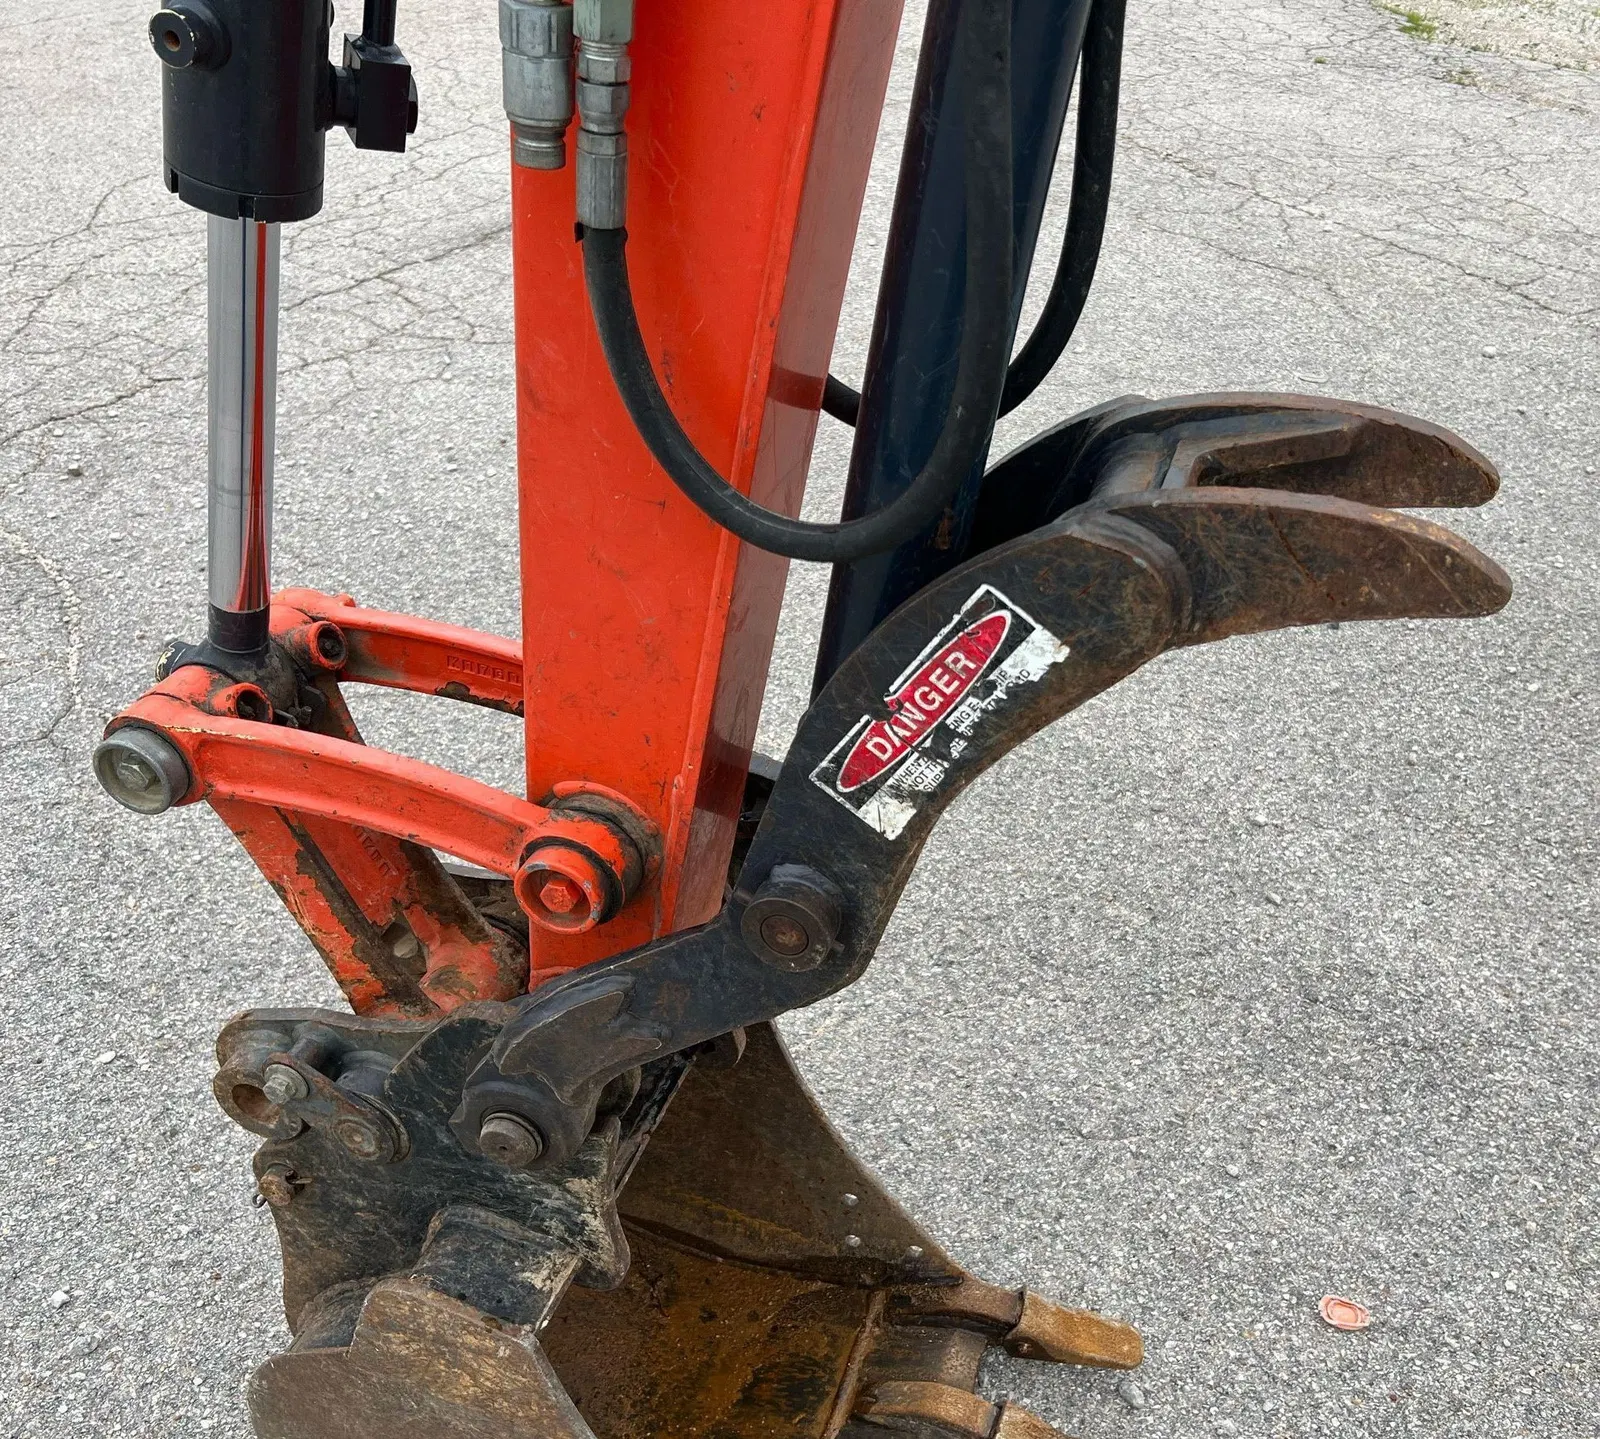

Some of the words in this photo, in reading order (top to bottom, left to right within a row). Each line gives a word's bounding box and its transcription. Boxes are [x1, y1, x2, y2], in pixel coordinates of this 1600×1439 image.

[865, 651, 976, 762] DANGER
[892, 761, 922, 787] WHEN
[908, 770, 929, 791] NOT
